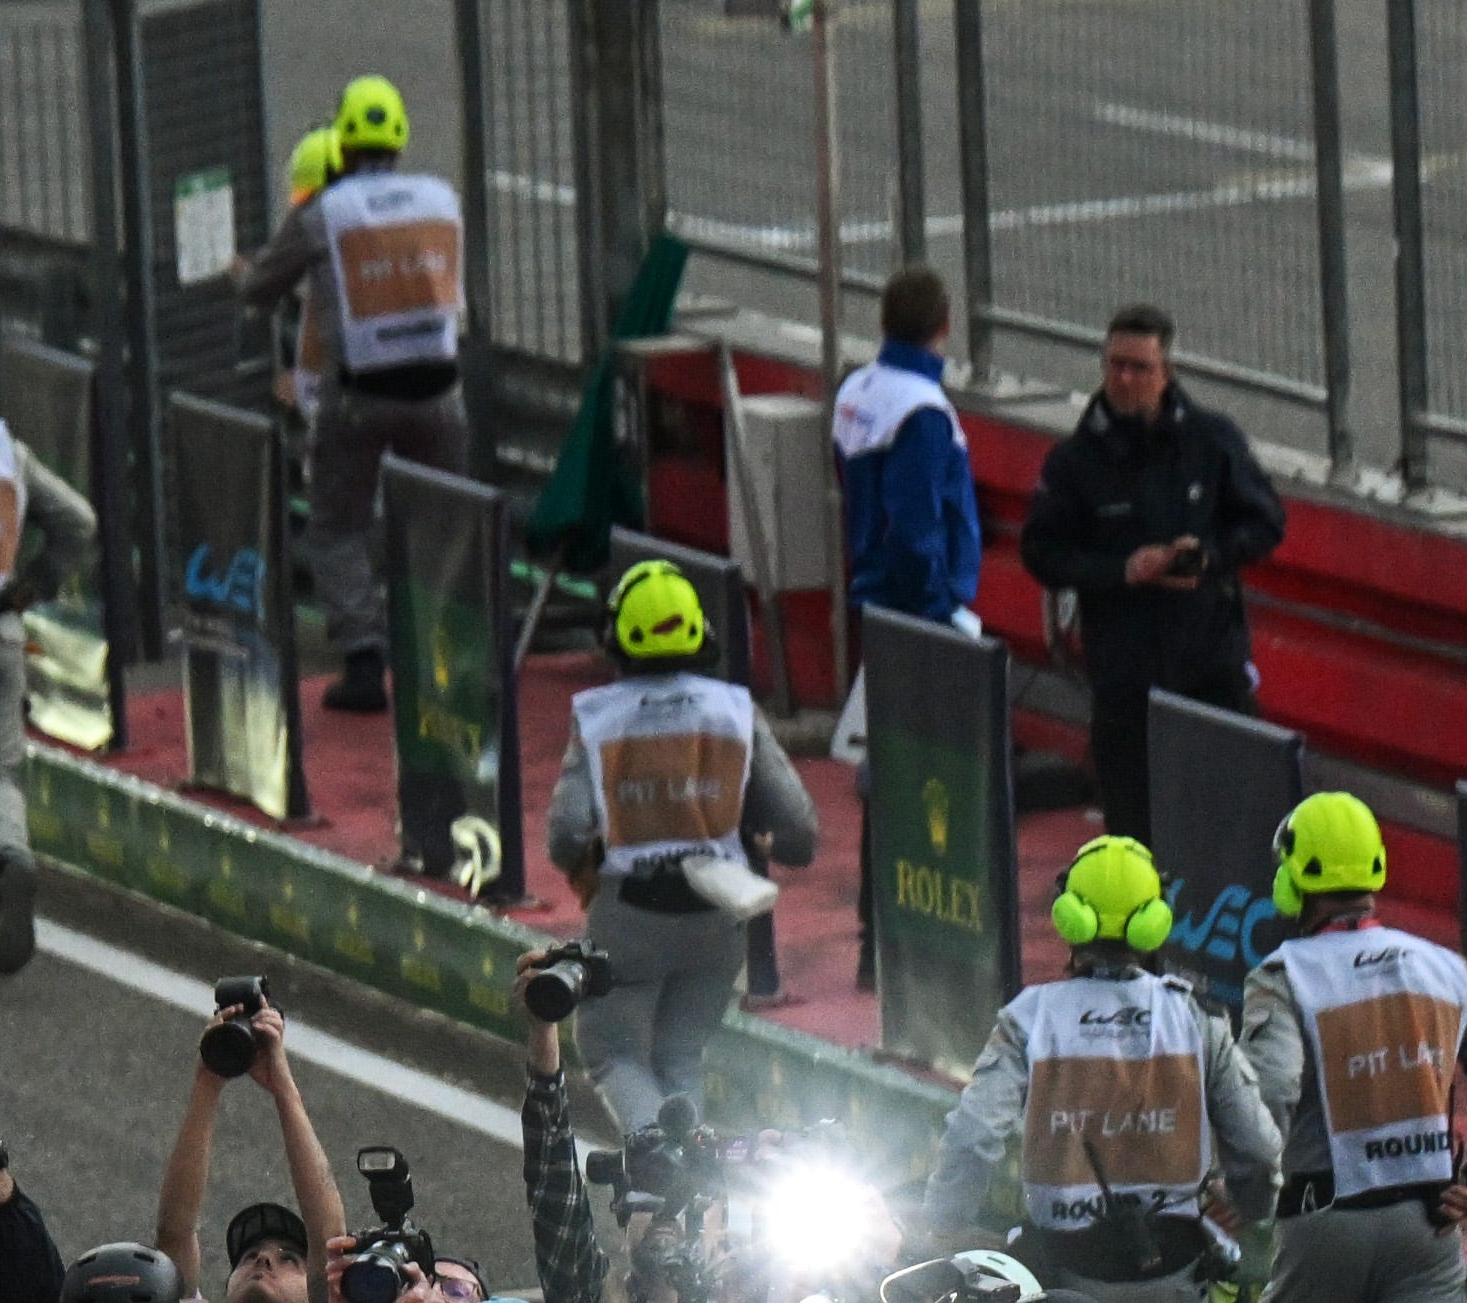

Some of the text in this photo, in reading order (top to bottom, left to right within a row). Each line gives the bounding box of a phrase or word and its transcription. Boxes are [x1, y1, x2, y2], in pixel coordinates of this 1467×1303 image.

[895, 857, 984, 933] ROLEX
[1347, 1052, 1389, 1080] PIT
[1049, 1107, 1178, 1137] PIT LANE
